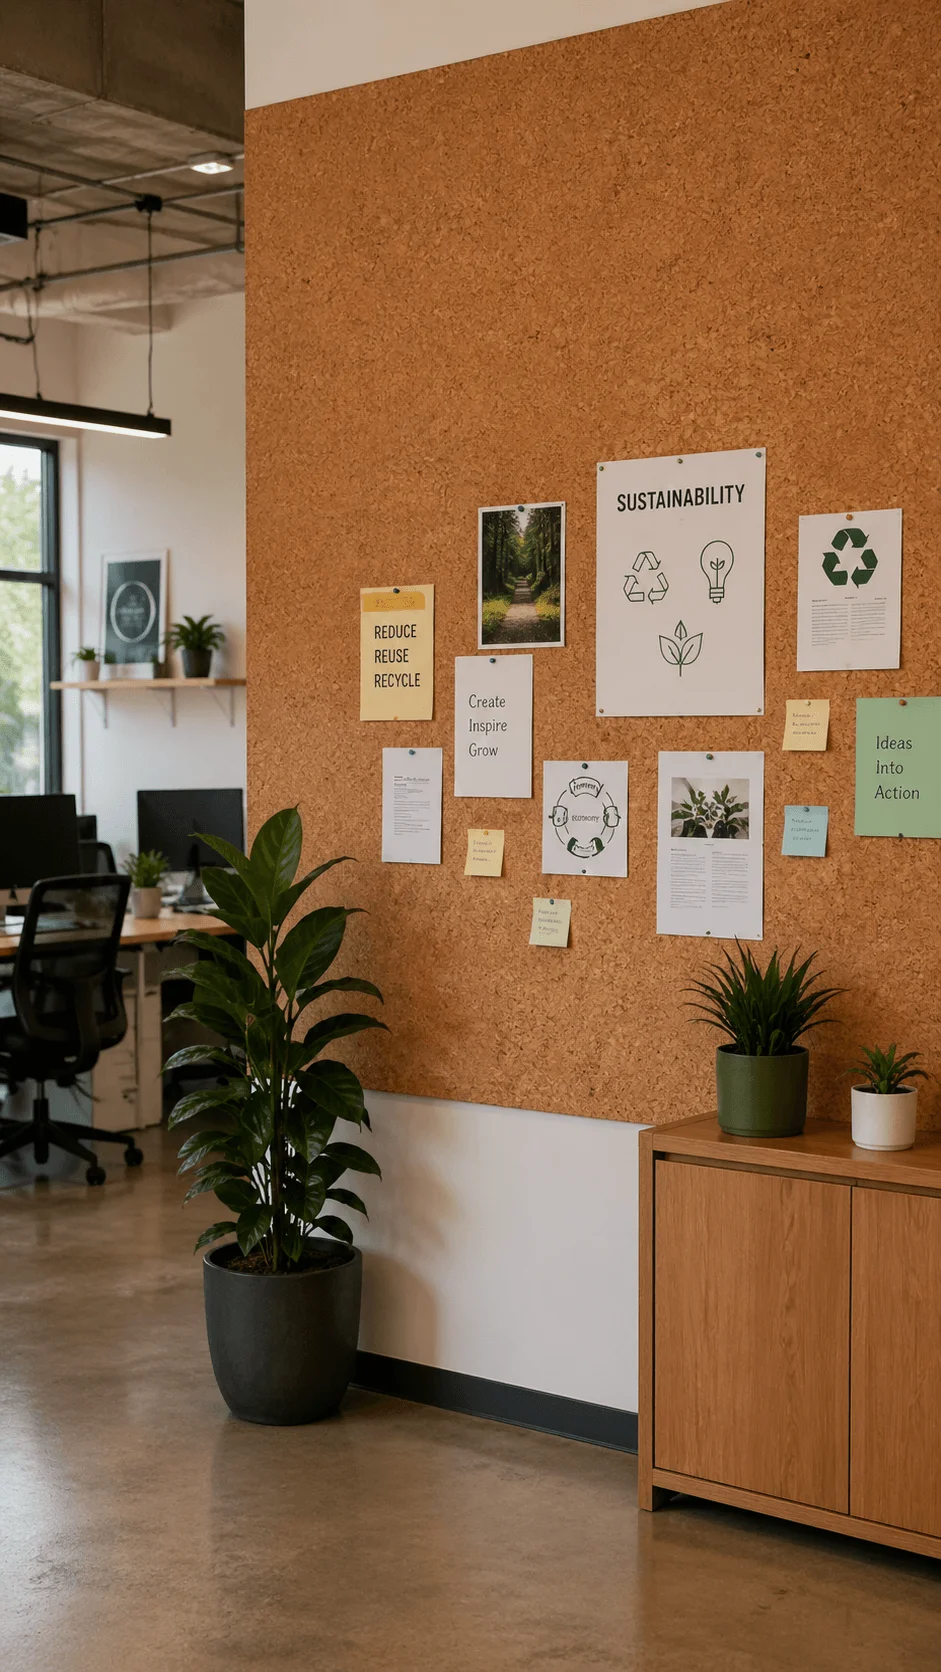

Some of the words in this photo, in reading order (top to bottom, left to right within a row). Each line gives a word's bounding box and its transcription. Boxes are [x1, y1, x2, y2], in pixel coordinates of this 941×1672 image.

[617, 484, 746, 513] SUSTAINABILITY
[374, 623, 418, 640] REDUCE
[374, 647, 409, 664] REUSE
[374, 672, 421, 688] RECYCLE
[468, 694, 506, 709] Create
[468, 719, 508, 736] Inspire
[876, 735, 913, 750] Ideas
[468, 743, 498, 758] Grow
[876, 760, 904, 775] Into
[875, 785, 920, 800] Action
